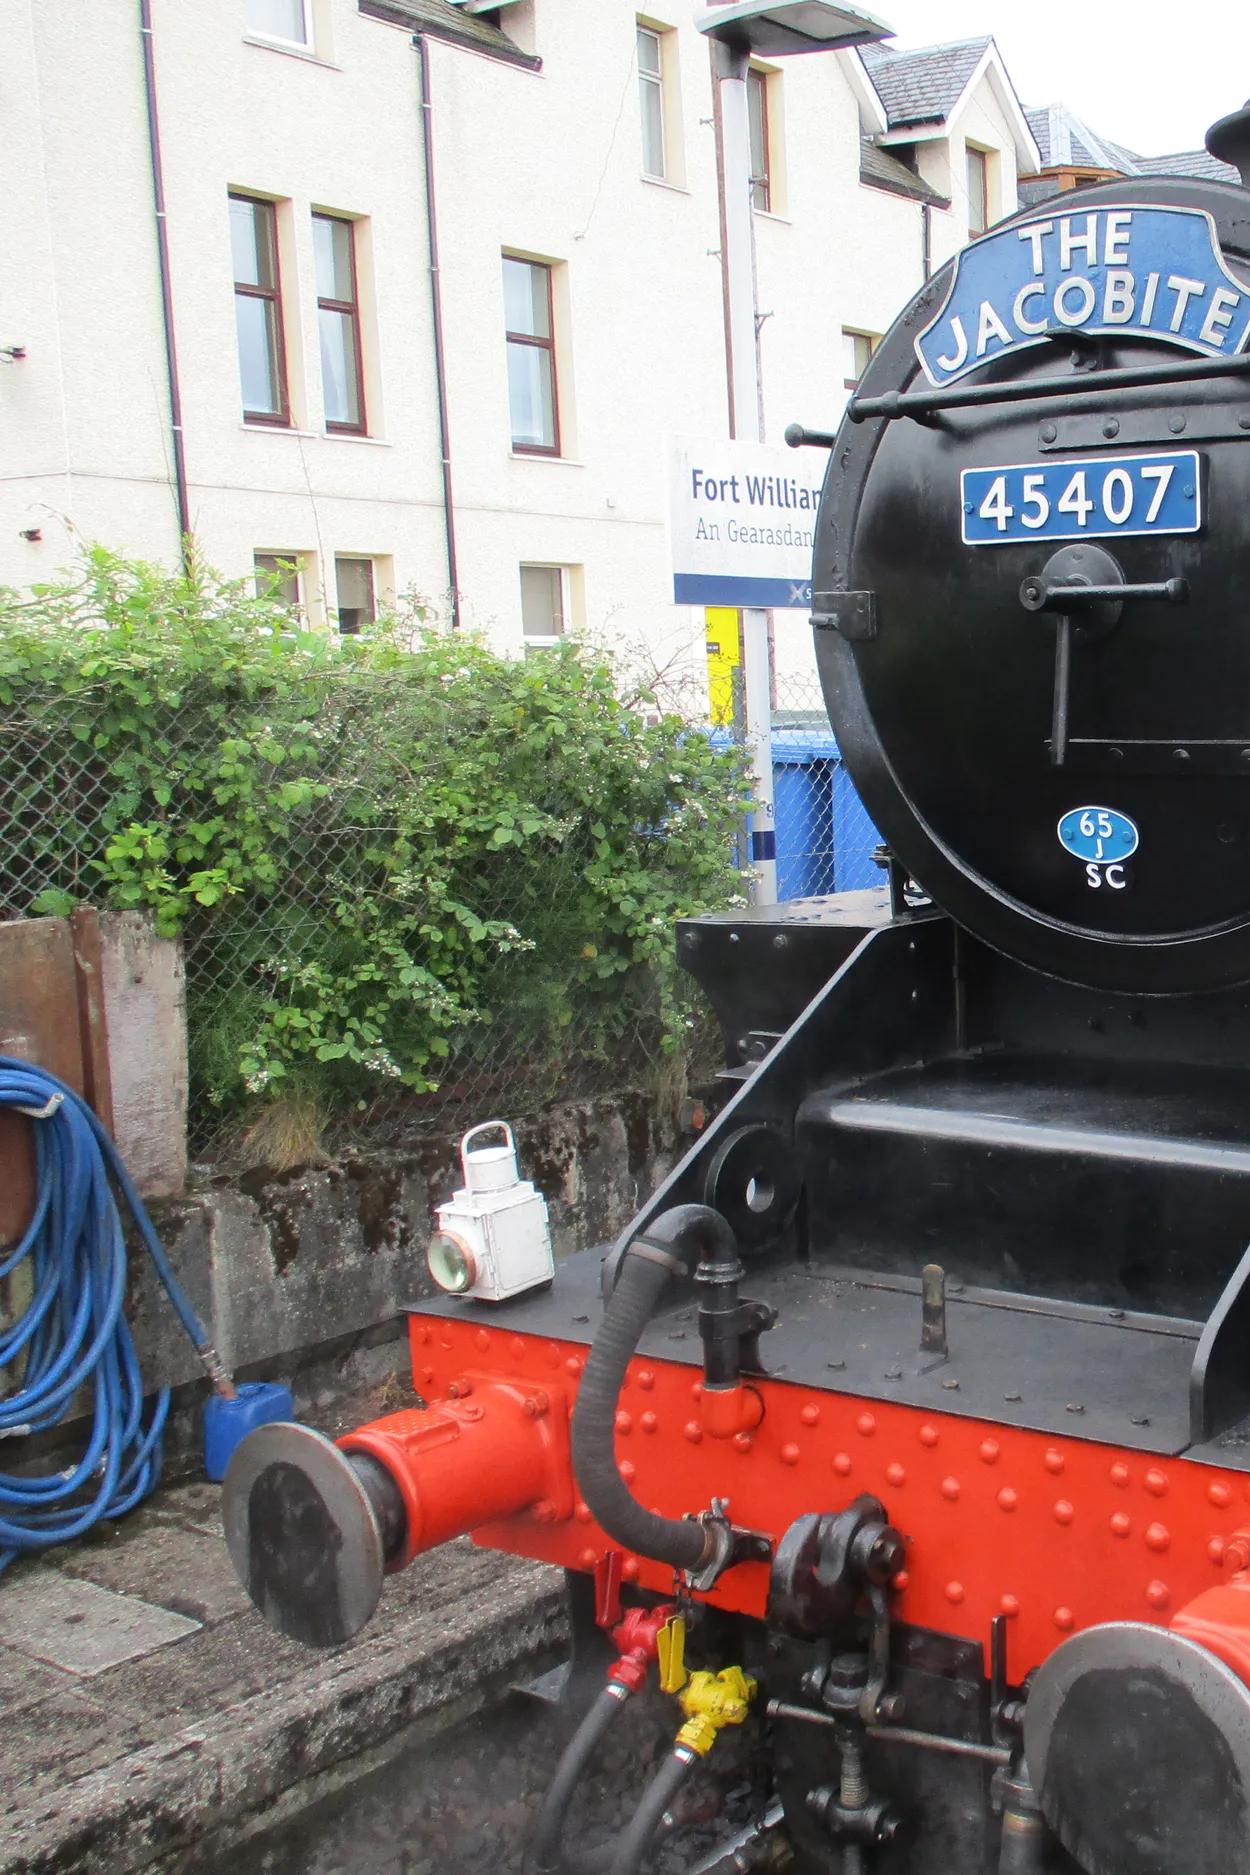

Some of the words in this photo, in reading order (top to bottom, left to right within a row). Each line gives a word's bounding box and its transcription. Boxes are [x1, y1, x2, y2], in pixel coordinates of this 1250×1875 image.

[1018, 212, 1133, 275] THE
[936, 270, 1240, 373] JACOBITE
[692, 468, 740, 504] Fort
[979, 464, 1176, 532] 45407
[695, 517, 720, 541] An
[1079, 811, 1113, 839] 65
[1095, 838, 1104, 859] J
[1085, 863, 1126, 889] SC
